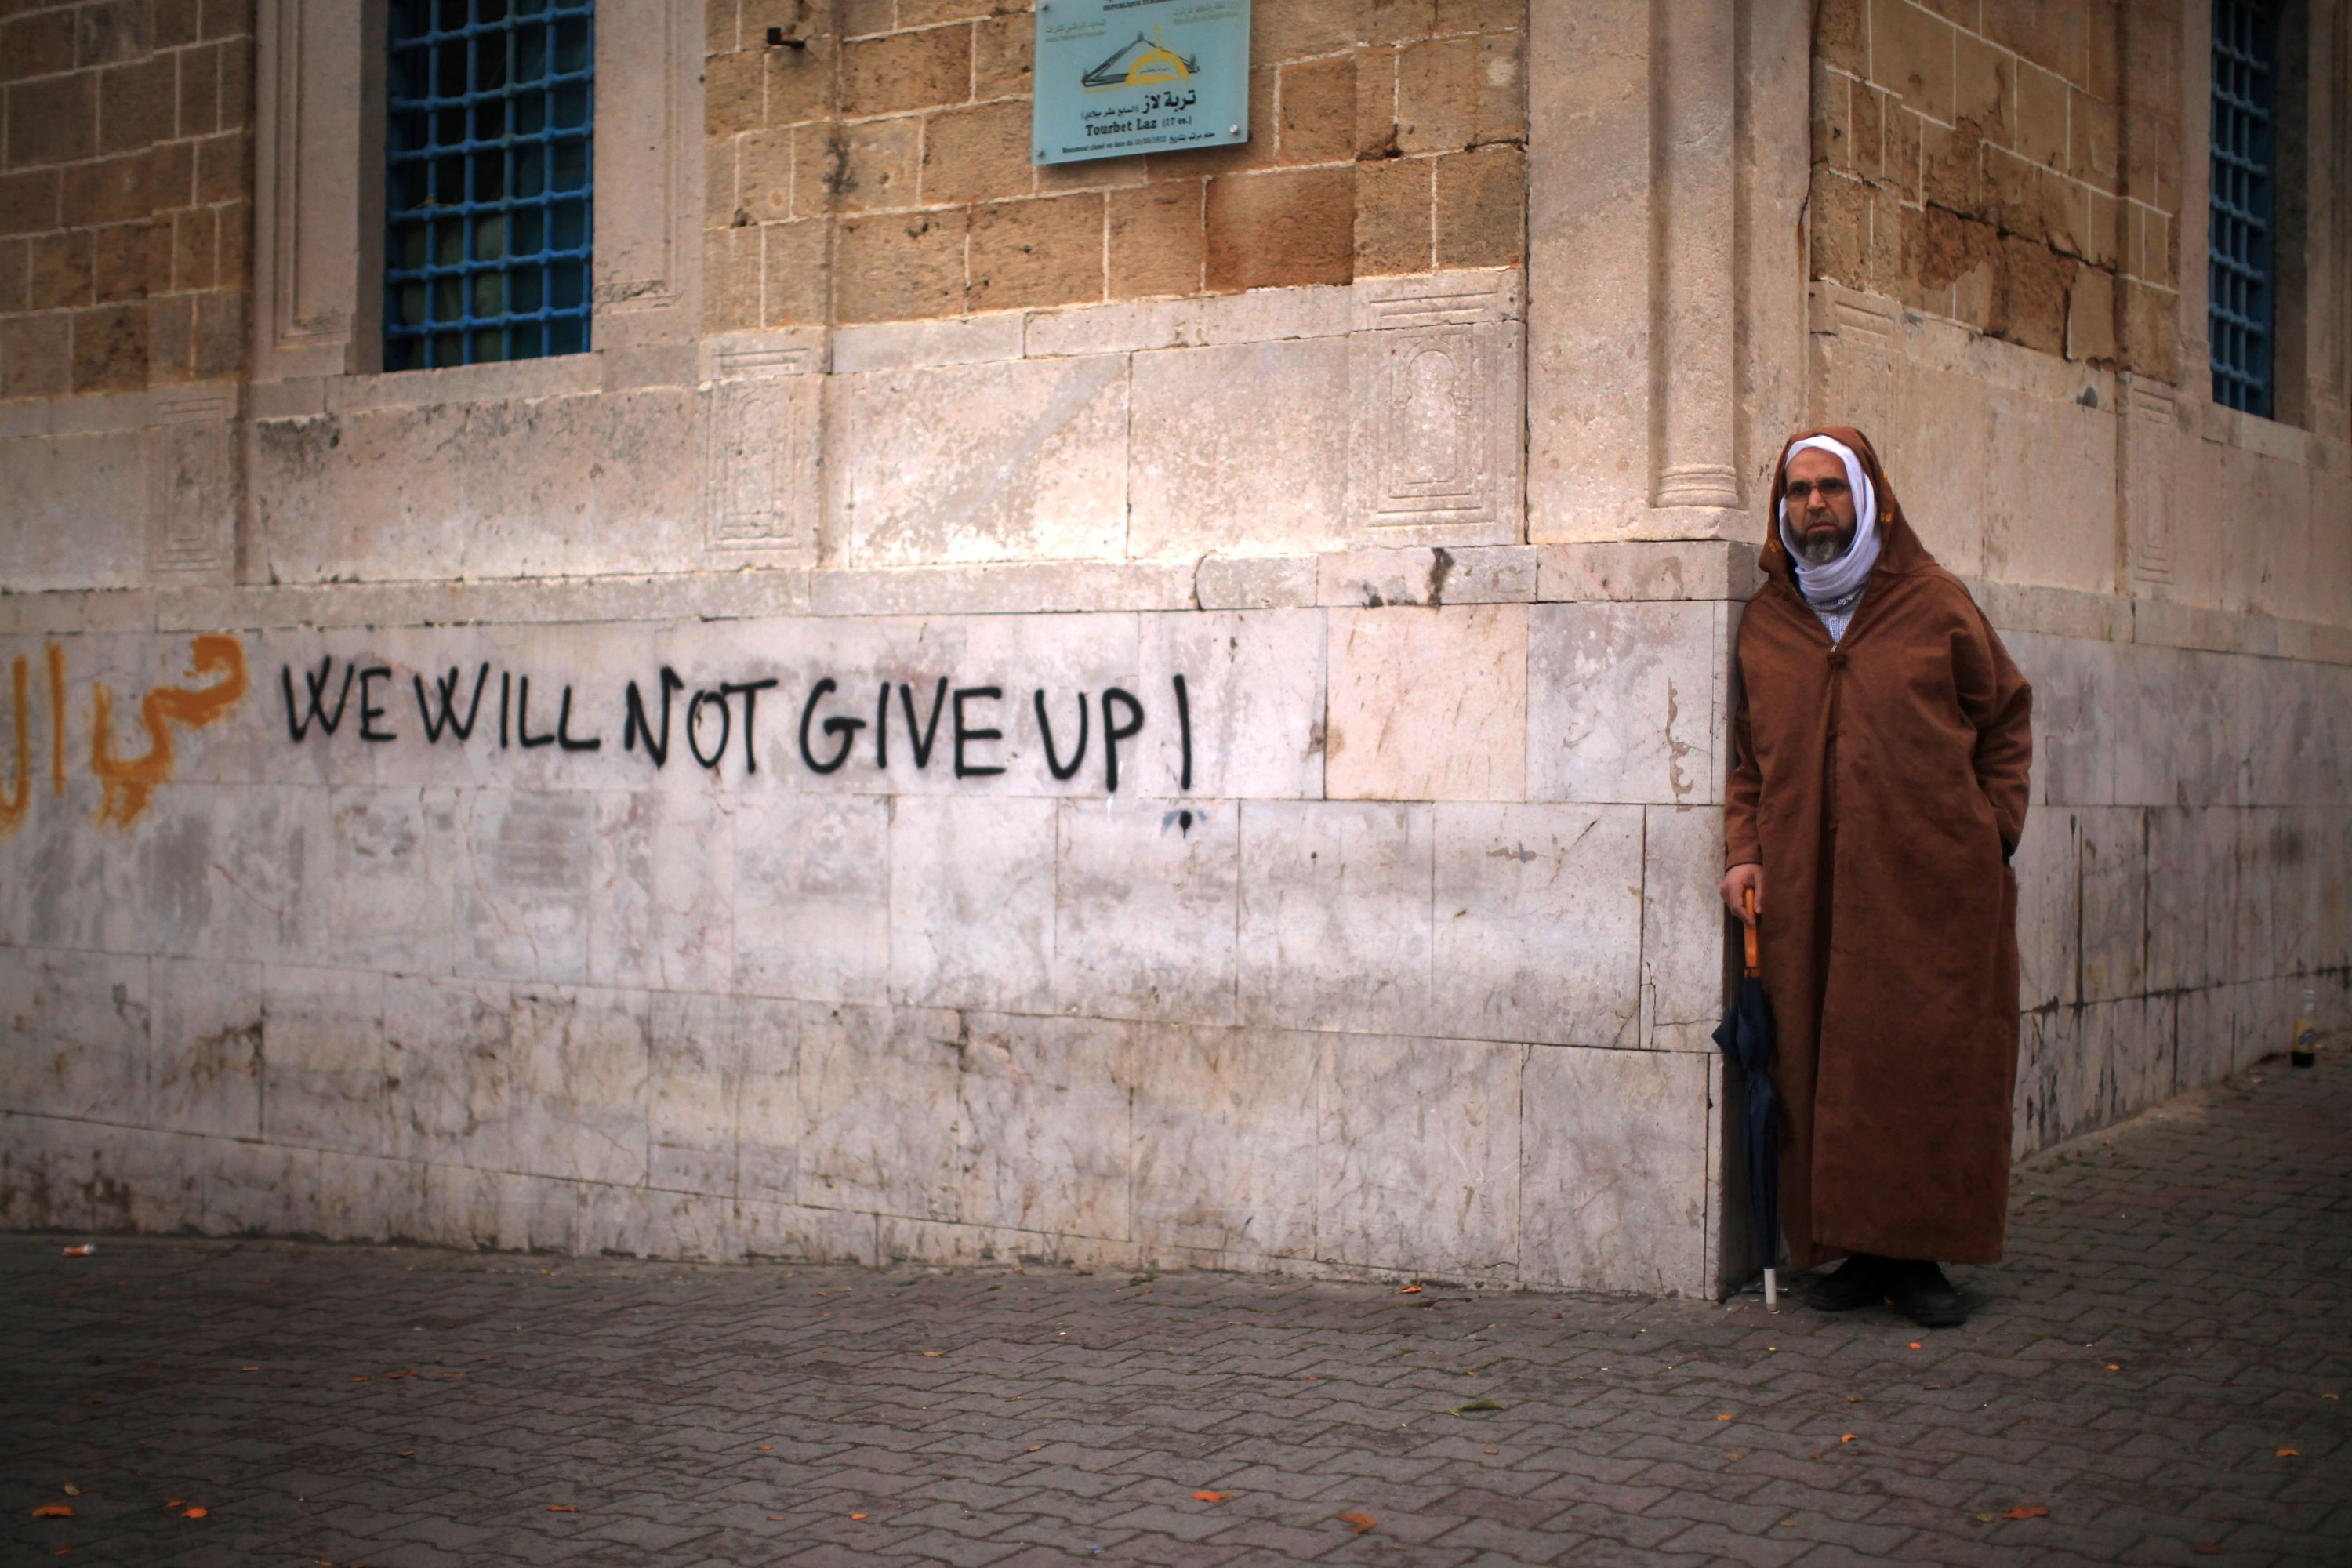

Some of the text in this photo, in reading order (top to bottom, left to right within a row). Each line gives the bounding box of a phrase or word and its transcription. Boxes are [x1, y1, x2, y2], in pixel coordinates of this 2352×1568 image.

[1142, 89, 1196, 114] تربة لاز
[1085, 120, 1132, 136] Tourbet
[1136, 118, 1157, 131] Laz
[281, 655, 1193, 839] WE WILL NOT GIVE UP!
